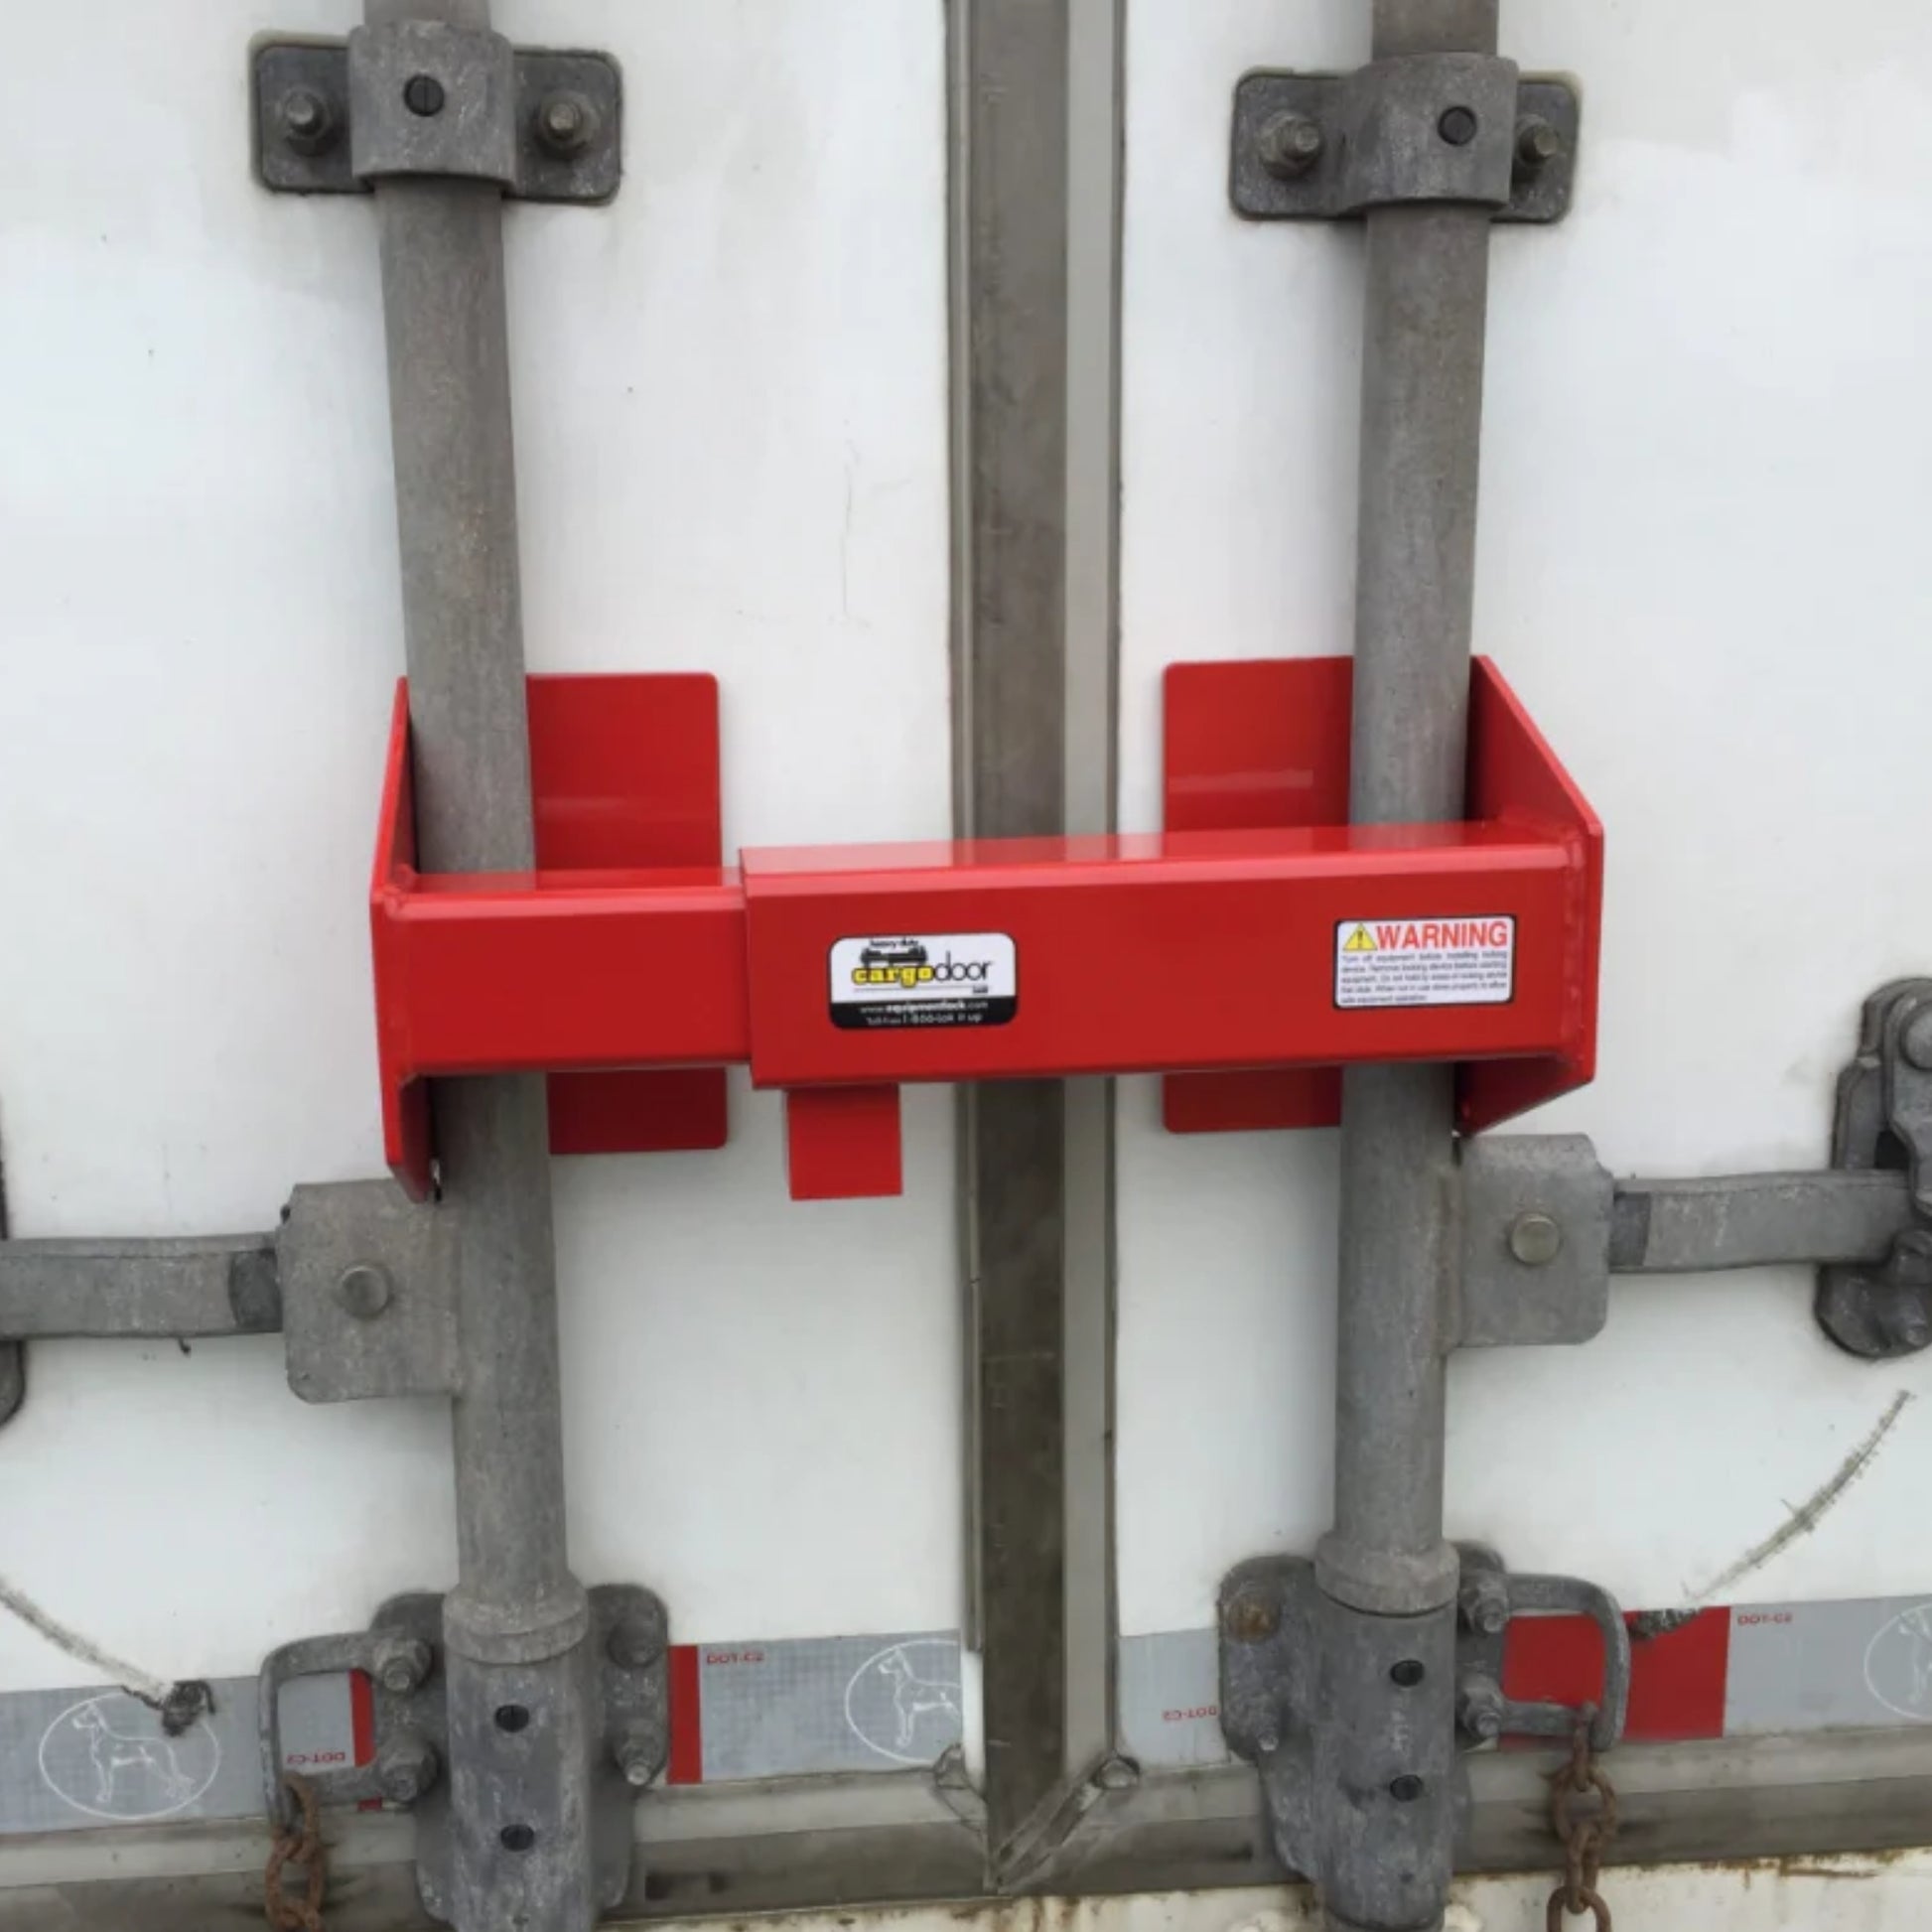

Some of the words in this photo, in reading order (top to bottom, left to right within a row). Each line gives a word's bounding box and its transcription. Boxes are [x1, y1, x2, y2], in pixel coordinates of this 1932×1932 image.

[1376, 920, 1507, 949] WARNING
[707, 1651, 763, 1664] DOT-C2
[287, 1750, 345, 1764] DOT-C2
